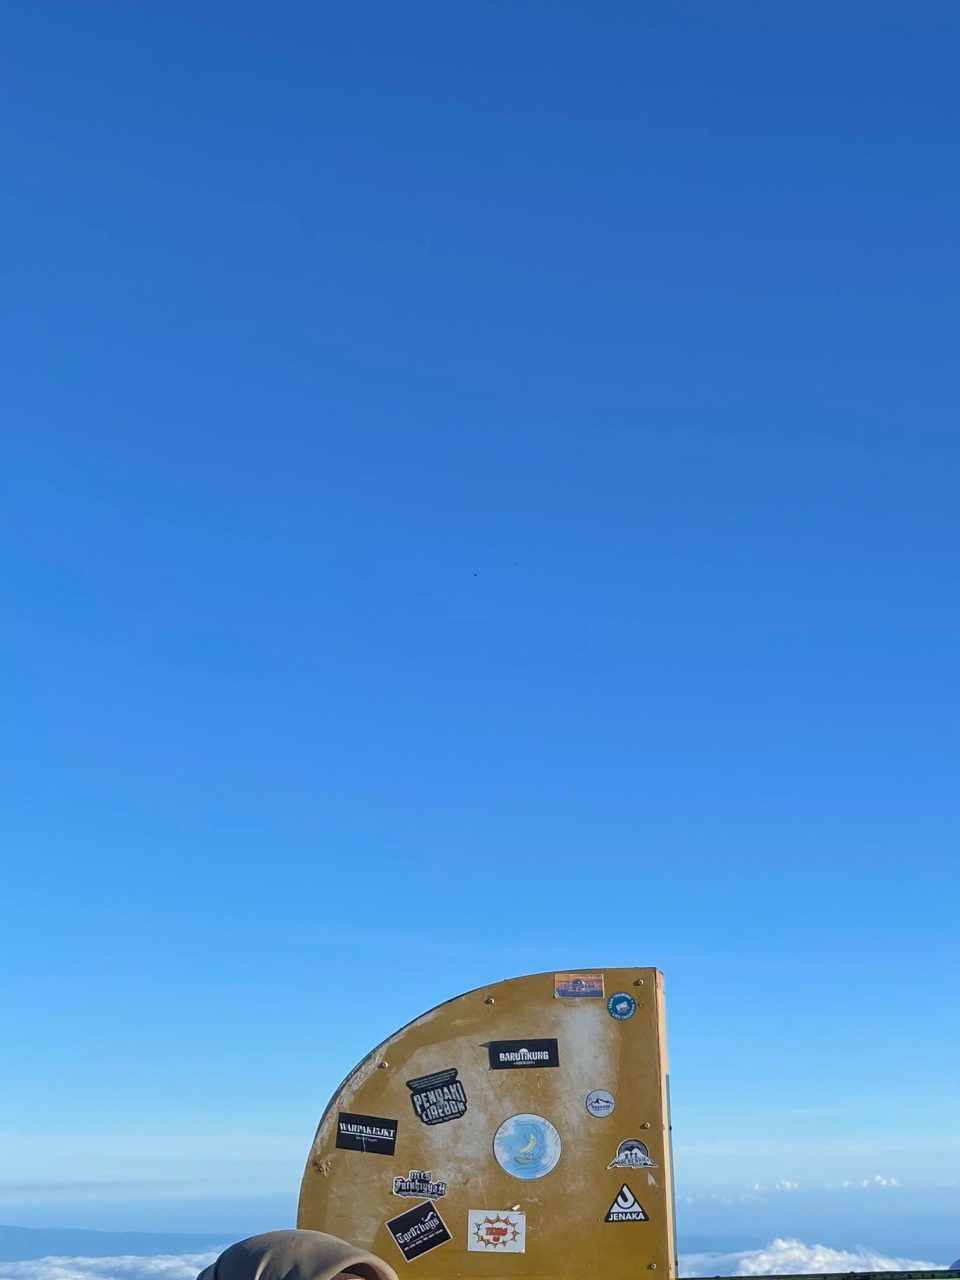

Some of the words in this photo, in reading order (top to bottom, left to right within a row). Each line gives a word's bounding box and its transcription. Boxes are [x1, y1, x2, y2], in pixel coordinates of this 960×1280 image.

[499, 1050, 549, 1062] BARUTIKUNG
[413, 1082, 466, 1115] PENDAKI
[422, 1100, 466, 1122] CIREBON
[608, 1212, 646, 1221] JENAKA
